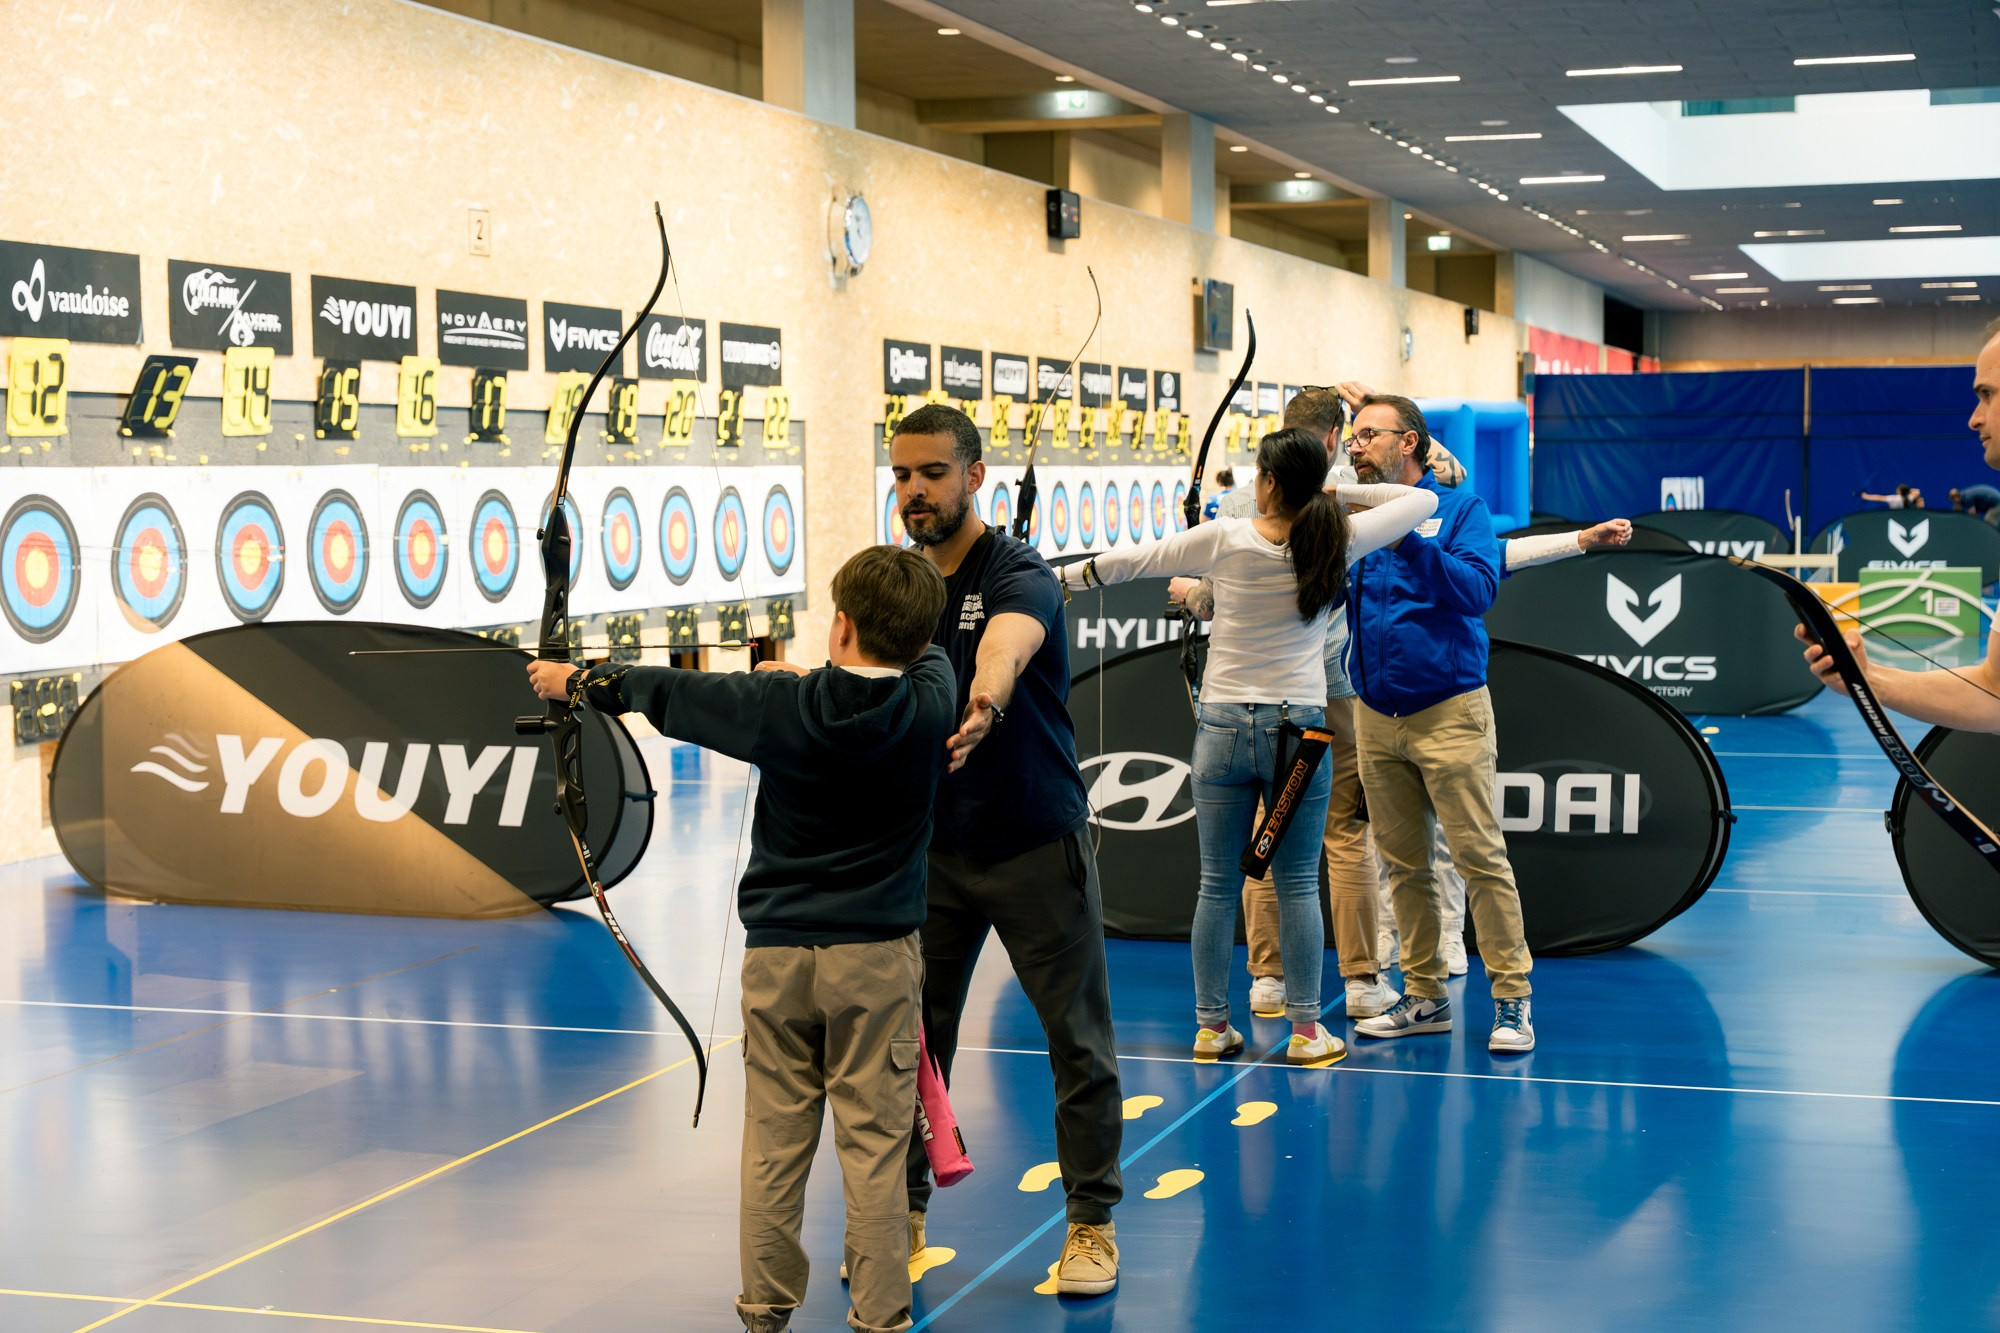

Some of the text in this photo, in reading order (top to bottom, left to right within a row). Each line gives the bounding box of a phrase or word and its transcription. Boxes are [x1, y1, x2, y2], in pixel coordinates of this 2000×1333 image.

[48, 284, 129, 318] vaudoise
[339, 299, 411, 339] YOUYI
[30, 353, 64, 423] 12
[143, 365, 191, 428] 13
[243, 366, 269, 418] 14
[330, 367, 359, 430] 15
[412, 370, 434, 425] 16
[617, 384, 638, 437] 19
[669, 390, 695, 437] 20
[767, 397, 788, 440] 22
[1919, 589, 1933, 615] 1
[1576, 655, 1717, 681] VICS
[1648, 686, 1693, 697] CTORY
[1852, 683, 1889, 736] ARCHERY
[216, 734, 540, 828] YOUYI
[1266, 759, 1309, 835] EASTON
[604, 911, 629, 945] HIT
